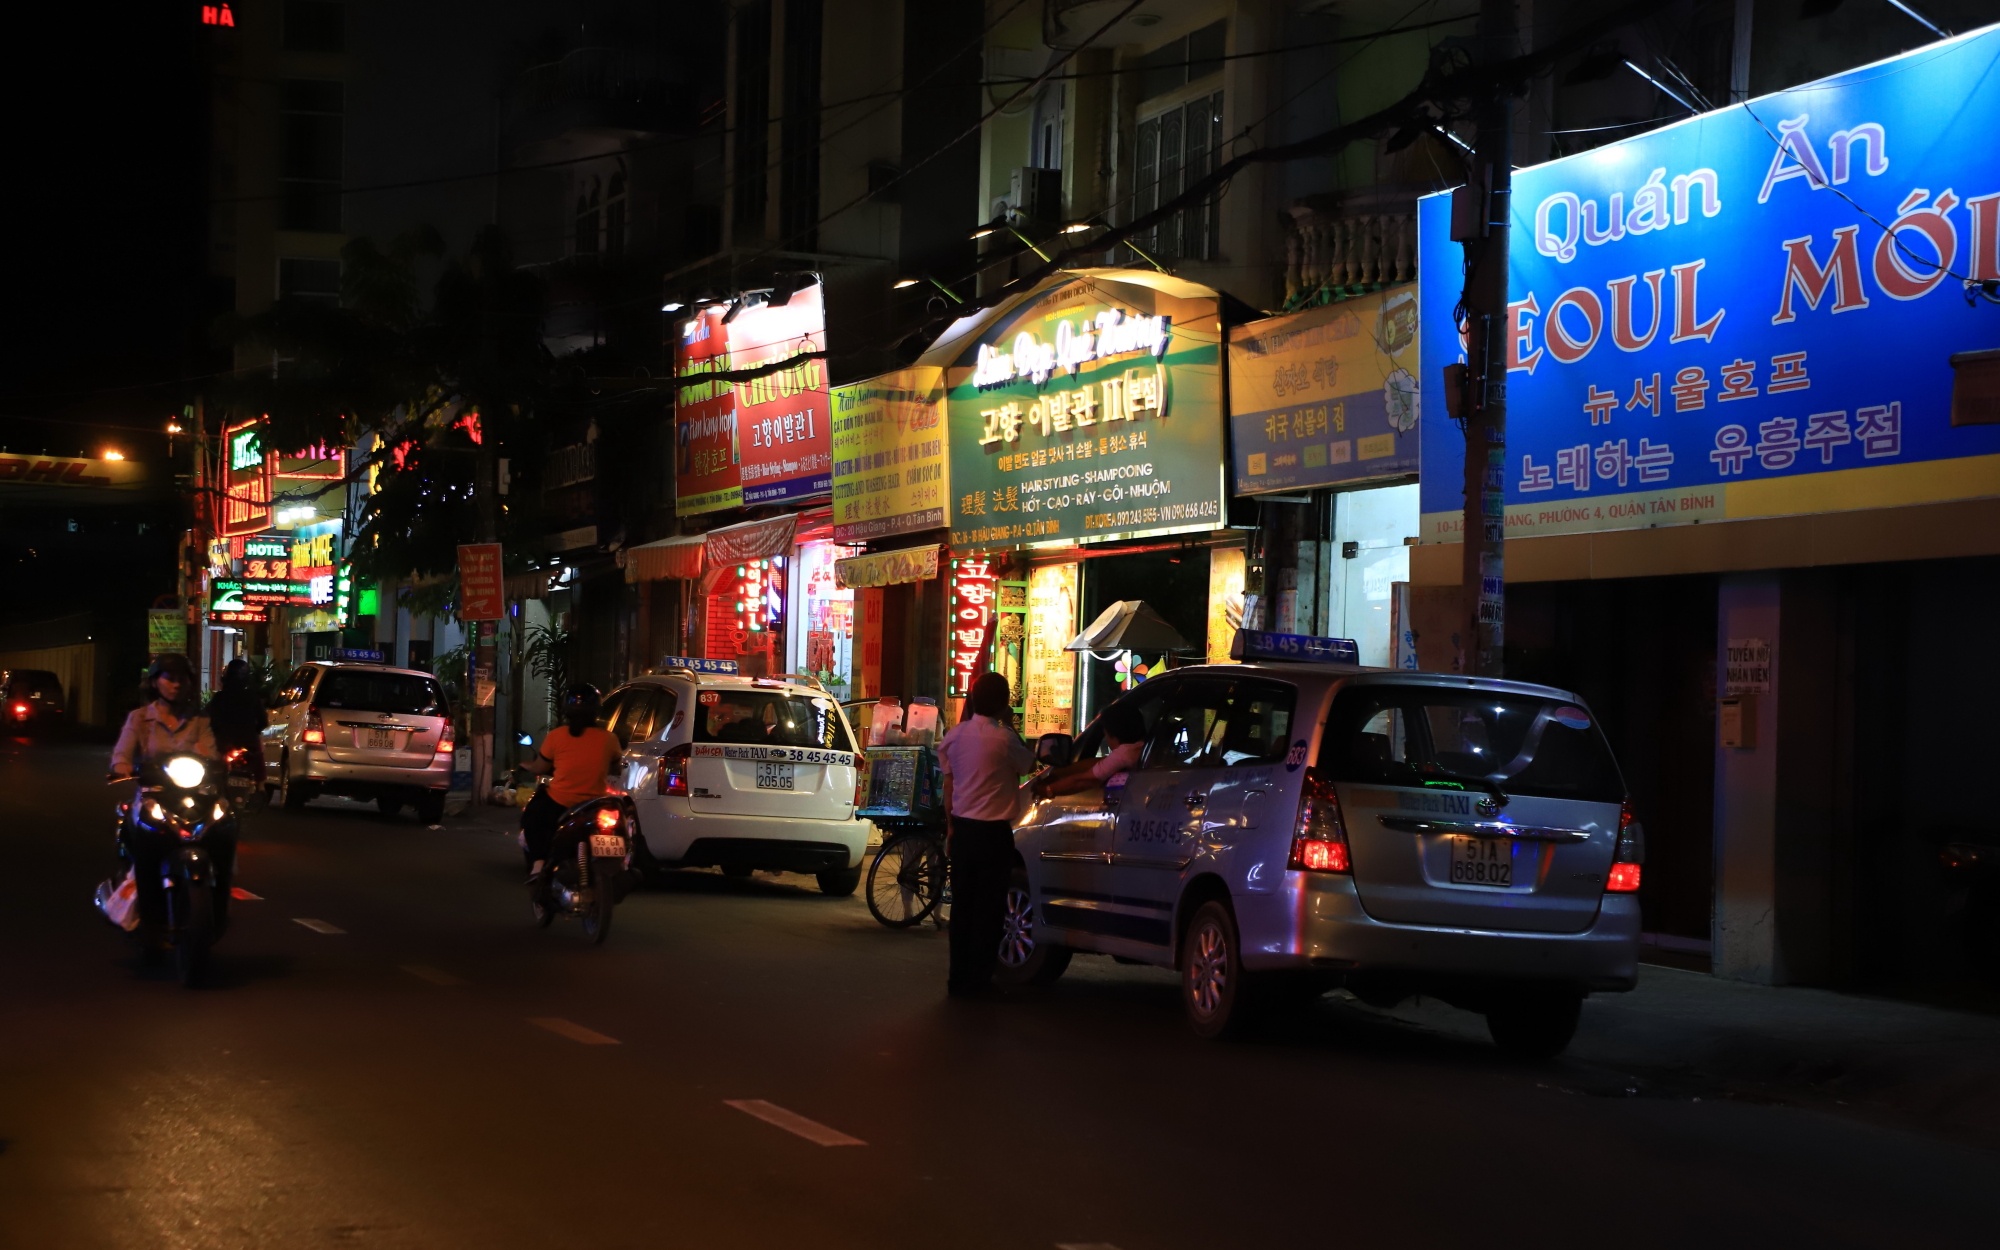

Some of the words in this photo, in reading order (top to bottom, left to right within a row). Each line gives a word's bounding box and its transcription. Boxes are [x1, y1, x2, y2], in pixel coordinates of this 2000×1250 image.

[203, 3, 235, 27] HÀ
[1533, 166, 1721, 263] Quán
[1757, 112, 1890, 205] Ăn
[1459, 258, 1725, 375] EOUL
[978, 401, 1022, 446] 고향
[1028, 384, 1101, 437] 이발관
[1519, 437, 1674, 494] 노래하는
[1710, 400, 1902, 477] 유흥주점
[1022, 497, 1041, 513] HỚT
[1047, 493, 1070, 511] CẠO
[1076, 487, 1096, 507] RÁY
[1102, 482, 1124, 504] GỘI
[1130, 478, 1171, 499] NHUỘM
[1539, 507, 1590, 525] PHƯỜNG
[1594, 508, 1605, 520] 4,
[1609, 501, 1646, 520] QUẬN
[1649, 496, 1676, 514] TÂN
[1680, 493, 1715, 510] BÌNH
[836, 526, 847, 538] ĐC:
[848, 525, 855, 535] 20
[856, 524, 868, 537] Hậu
[868, 520, 886, 533] Giang
[926, 510, 942, 522] Bình
[246, 544, 287, 557] HOTEL
[1254, 633, 1274, 651] 38
[1280, 636, 1299, 653] 45
[1304, 638, 1323, 656] 45
[1329, 641, 1349, 658] 45
[672, 658, 684, 667] 38
[688, 659, 700, 669] 45
[704, 660, 717, 670] 45
[720, 661, 733, 672] 45
[700, 693, 719, 702] 837
[750, 747, 767, 759] TAXI
[789, 750, 803, 761] 38
[806, 752, 821, 763] 45
[823, 752, 837, 764] 45
[838, 754, 851, 765] 45
[1288, 745, 1305, 767] 683
[766, 763, 785, 775] 51F
[758, 775, 792, 788] 205.05
[1442, 794, 1470, 815] TAXI
[1467, 839, 1498, 861] 51A
[1455, 861, 1510, 883] 668.02
